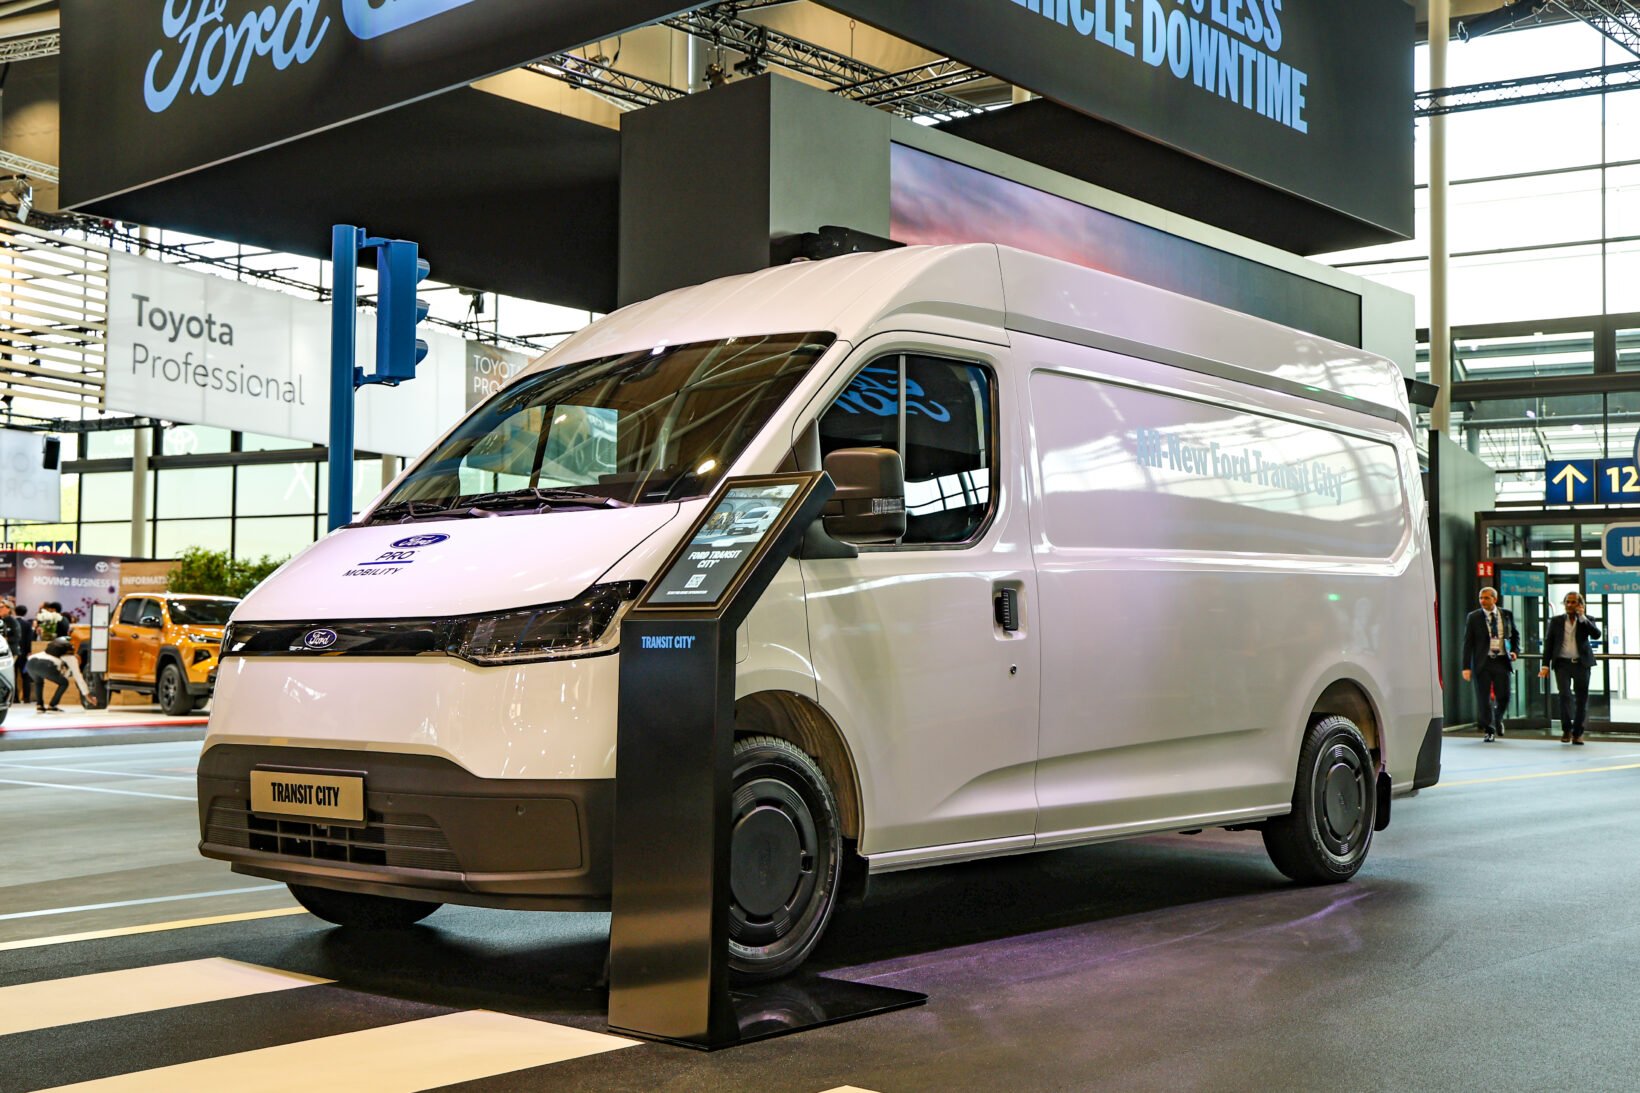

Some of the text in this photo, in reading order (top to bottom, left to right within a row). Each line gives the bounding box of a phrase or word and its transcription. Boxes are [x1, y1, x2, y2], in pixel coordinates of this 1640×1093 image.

[1143, 0, 1308, 134] DOWNTIME
[131, 293, 234, 347] Toyota
[131, 343, 305, 406] Professional
[473, 354, 520, 379] TOYOT
[1210, 441, 1252, 484] Ford
[1252, 449, 1311, 493] Transit
[1606, 465, 1640, 494] 12
[375, 550, 416, 561] PRO
[688, 549, 743, 560] FORD TRANSIT
[33, 575, 70, 586] MOVING
[71, 577, 109, 588] BUSINESS
[122, 575, 168, 585] INFORMATI
[342, 567, 404, 576] MOBILITY
[641, 635, 673, 649] TRANSIT
[271, 782, 340, 807] TRANSIT CITY
